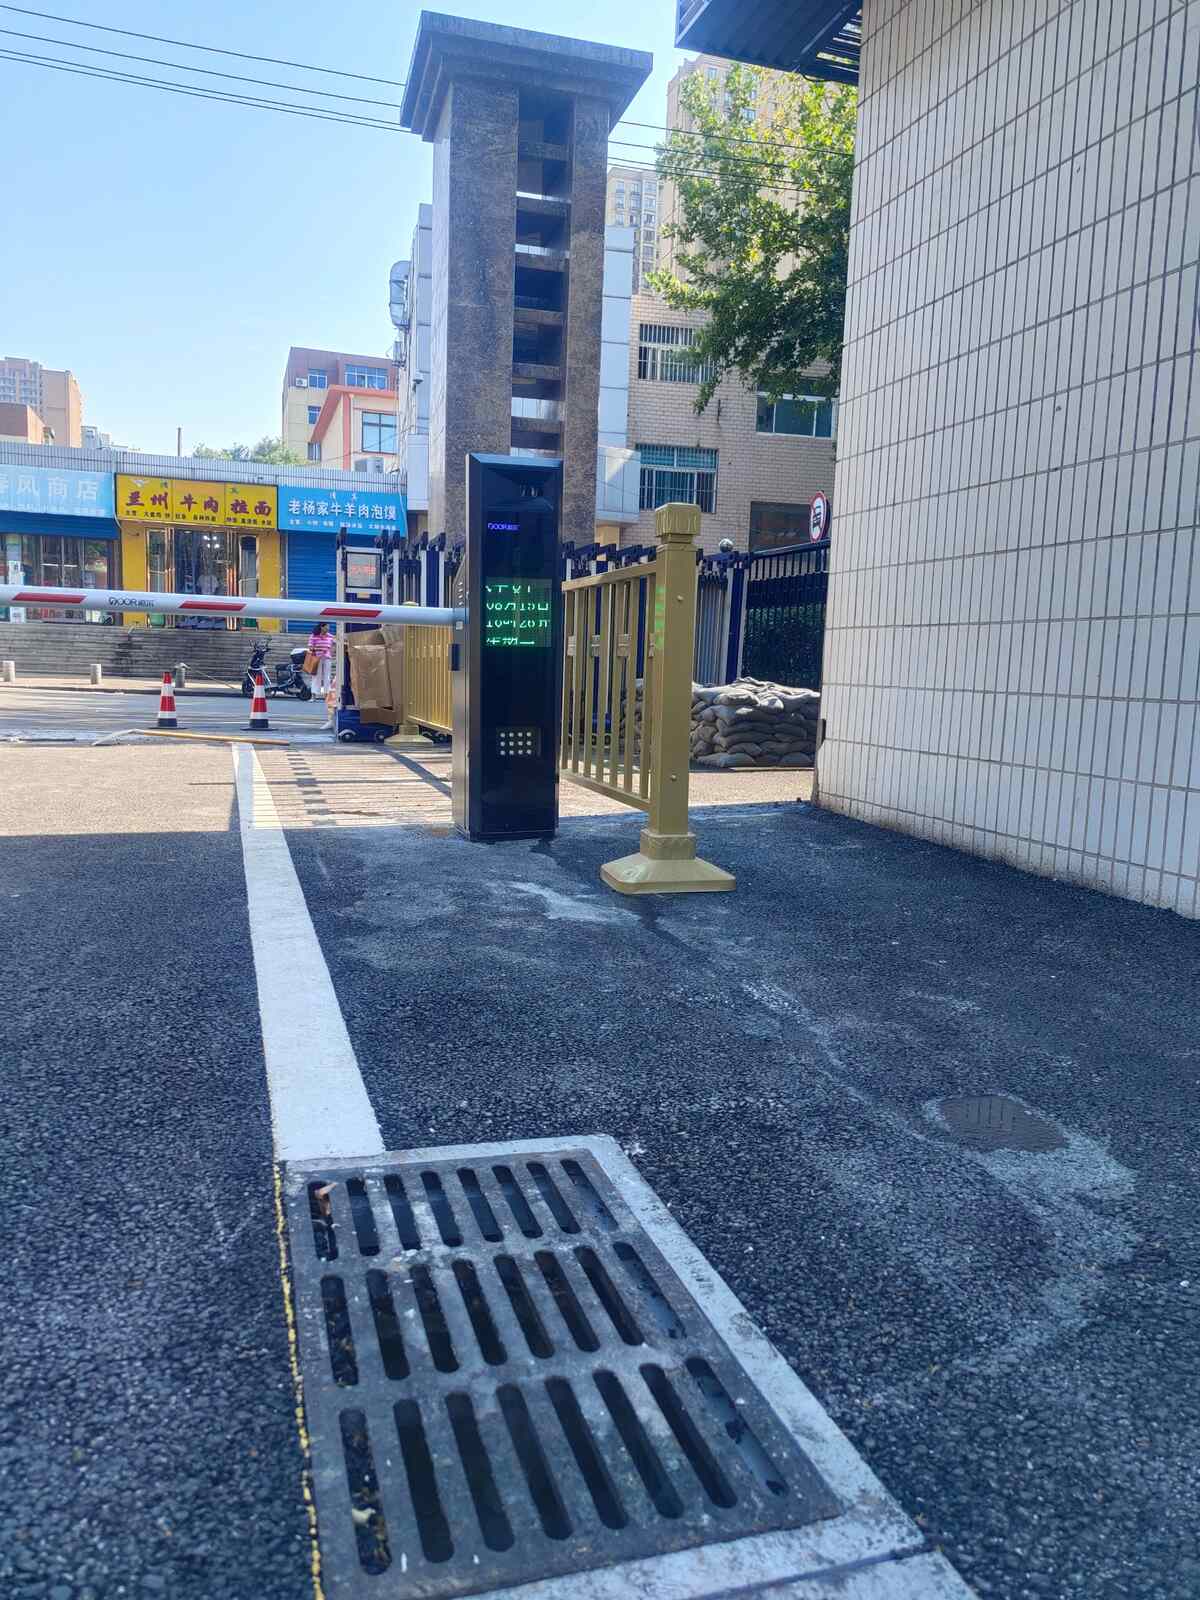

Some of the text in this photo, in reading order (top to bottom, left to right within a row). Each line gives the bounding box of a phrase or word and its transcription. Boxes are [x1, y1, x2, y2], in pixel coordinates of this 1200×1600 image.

[126, 490, 272, 517] 兰州牛肉拉面
[287, 498, 397, 521] 老杨家牛羊肉泡馍
